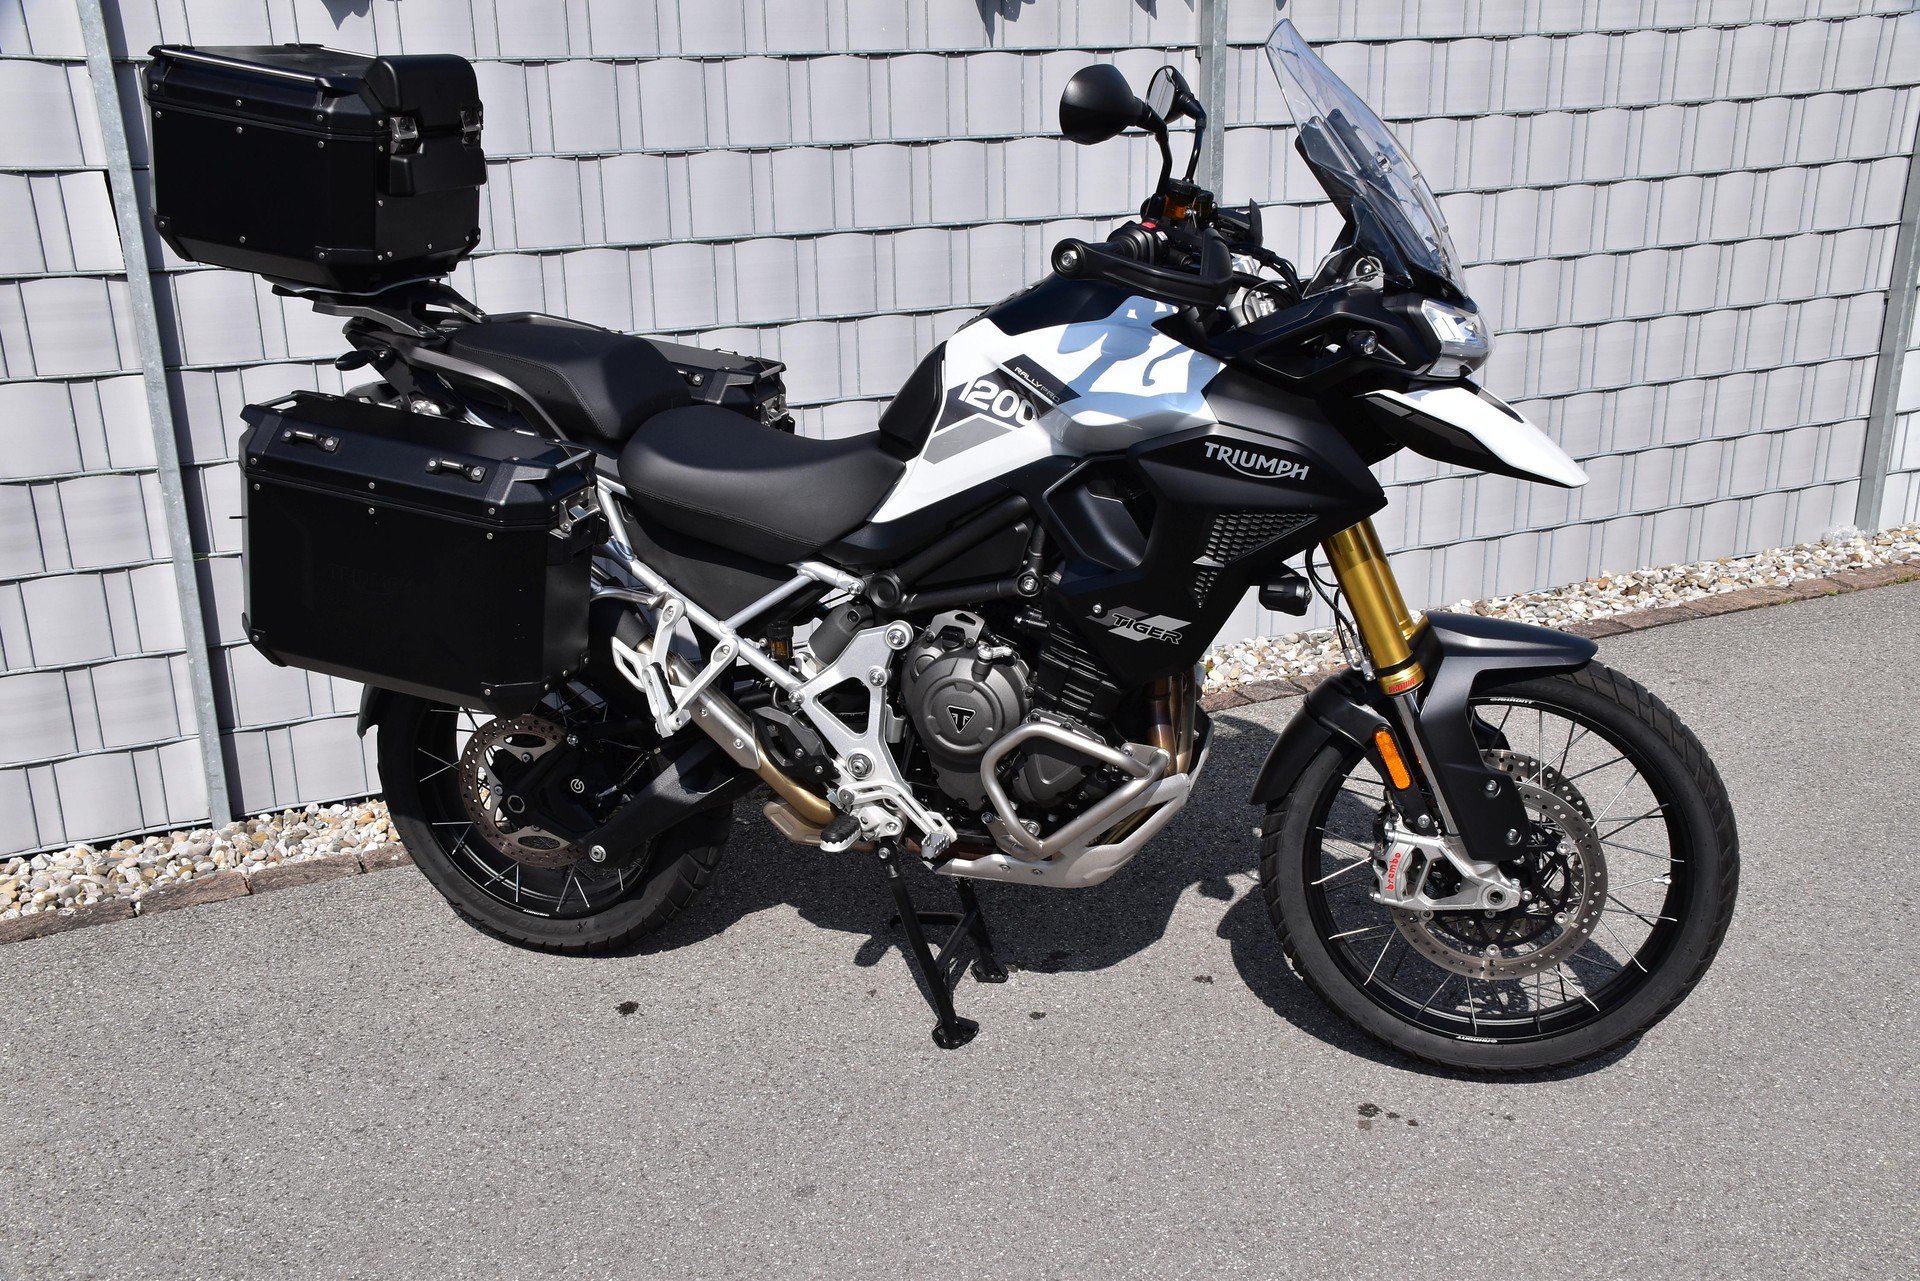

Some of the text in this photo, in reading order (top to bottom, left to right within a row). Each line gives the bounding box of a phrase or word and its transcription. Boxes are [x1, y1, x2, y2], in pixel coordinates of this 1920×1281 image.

[957, 379, 1039, 427] 1200
[1204, 441, 1310, 481] TRIUMPH
[1111, 612, 1183, 645] TIGER
[1384, 852, 1401, 891] brembo
